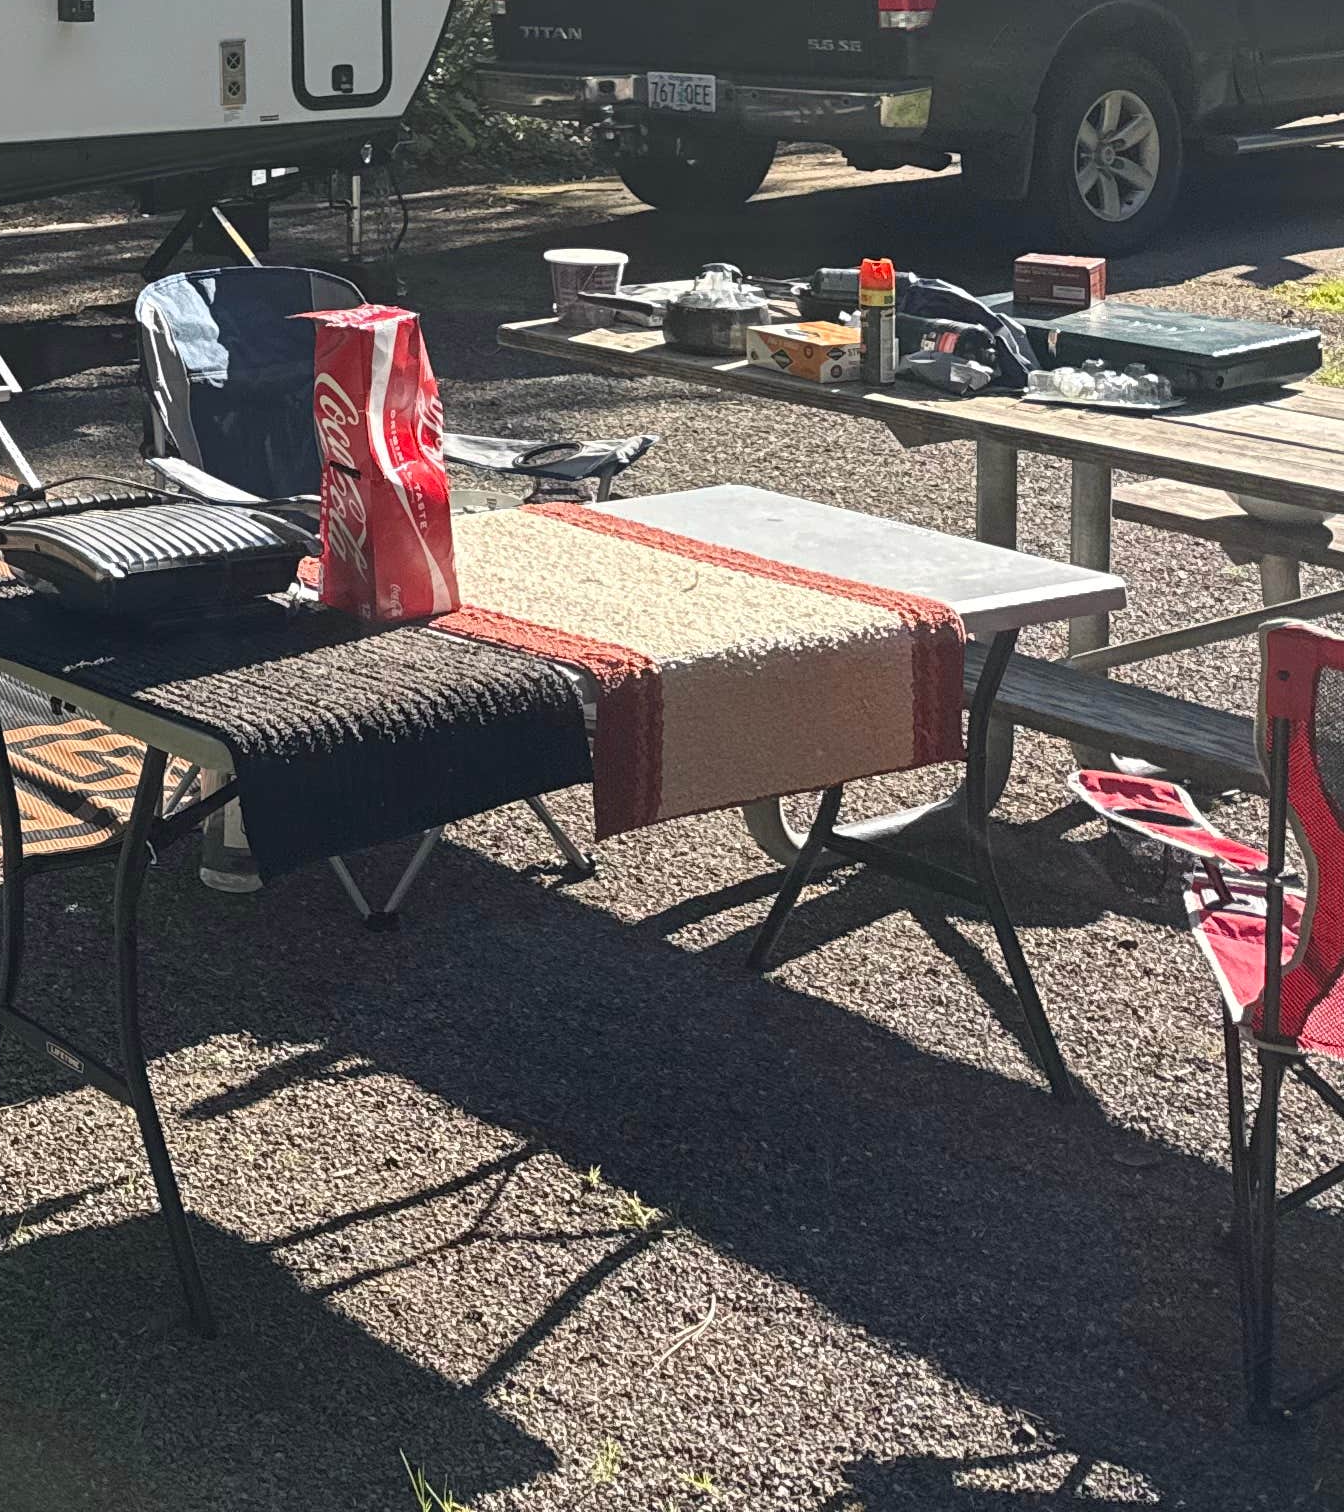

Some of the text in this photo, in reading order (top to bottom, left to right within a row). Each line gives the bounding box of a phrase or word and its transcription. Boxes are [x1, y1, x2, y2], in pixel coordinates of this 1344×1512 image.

[519, 25, 583, 40] TITAN
[650, 81, 675, 104] 767
[314, 372, 368, 584] CocaCola
[414, 482, 429, 530] TASTE
